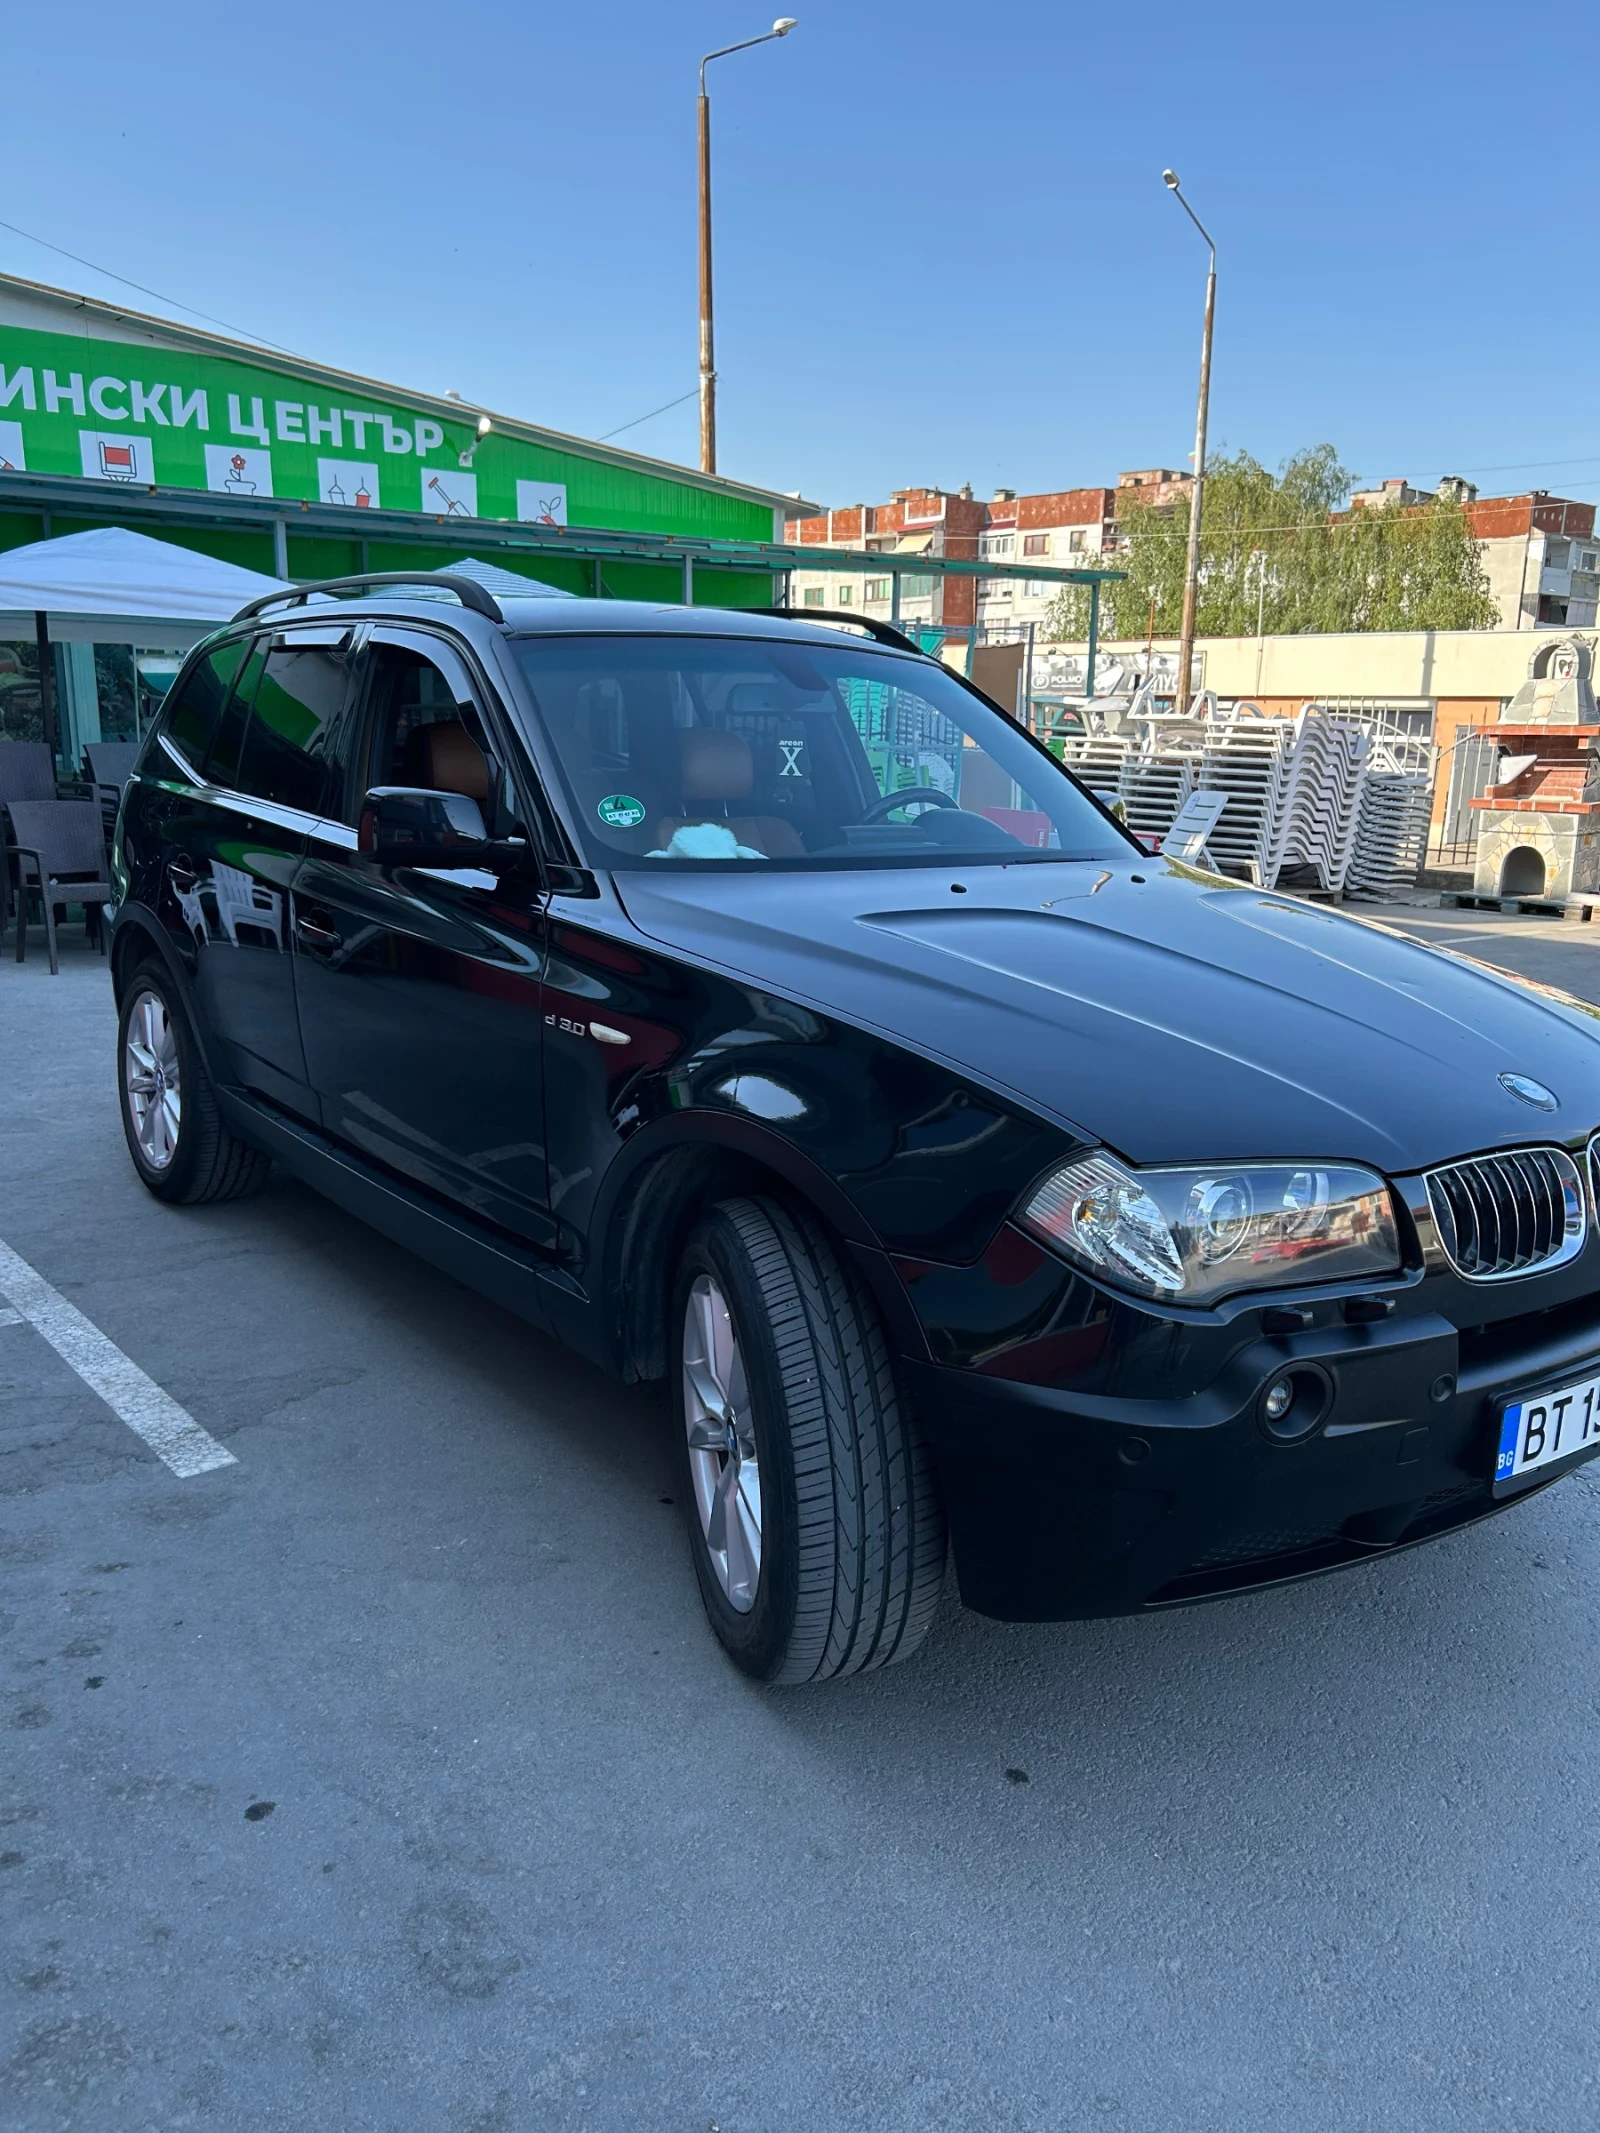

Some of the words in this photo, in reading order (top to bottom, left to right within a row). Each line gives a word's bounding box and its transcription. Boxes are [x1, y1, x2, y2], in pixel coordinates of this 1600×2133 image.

[0, 363, 209, 431] ИНСКИ
[228, 393, 443, 457] ЦЕНТЪР
[1051, 674, 1083, 684] POLMO
[779, 746, 804, 777] X
[614, 796, 627, 810] 4
[545, 1014, 556, 1027] d
[1522, 1395, 1574, 1464] BT
[1498, 1450, 1514, 1470] BG
